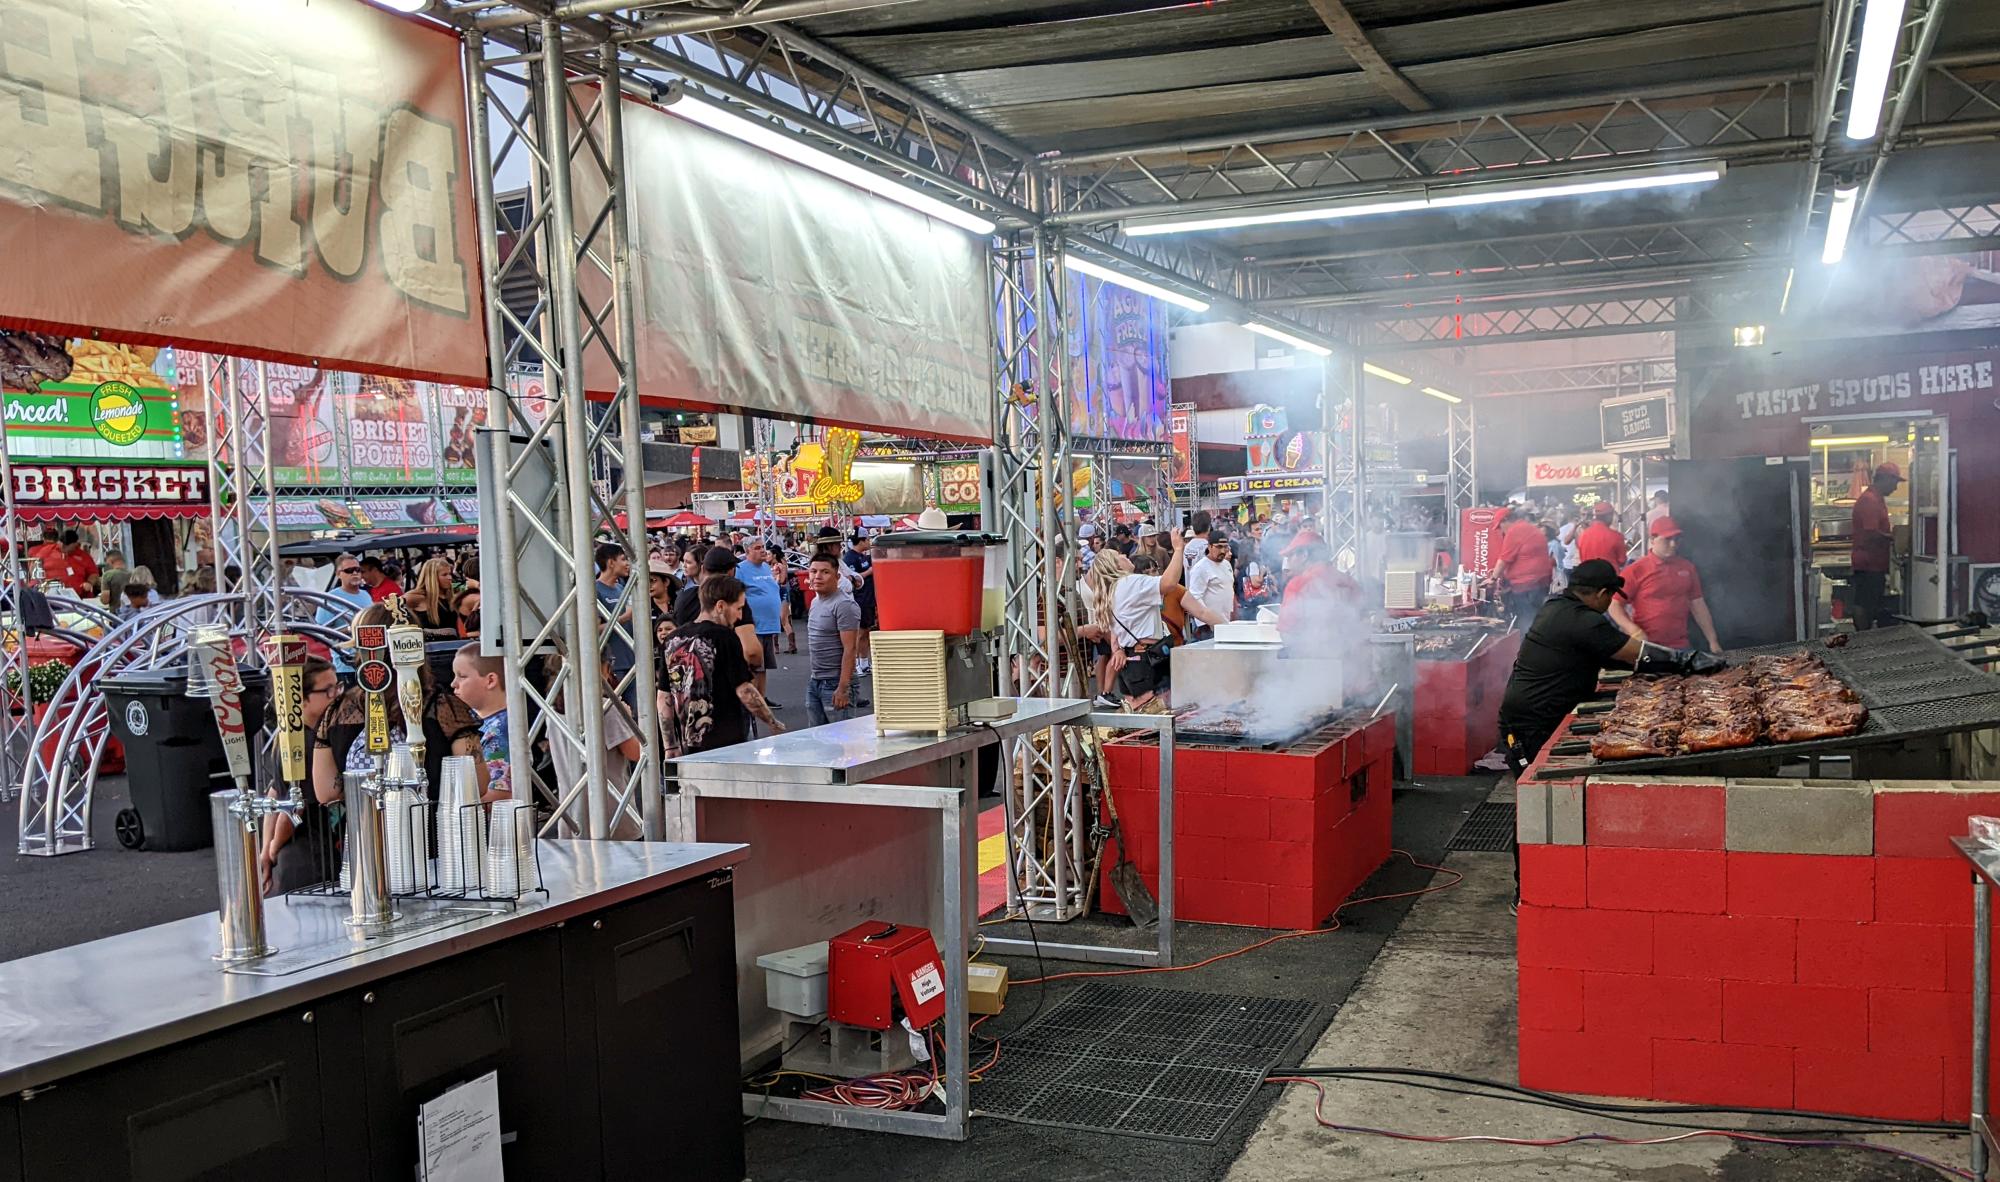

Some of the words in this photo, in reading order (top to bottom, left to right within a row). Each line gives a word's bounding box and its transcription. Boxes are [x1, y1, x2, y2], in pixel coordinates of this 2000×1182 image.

[100, 382, 132, 397] FRESH
[1736, 383, 1820, 418] TASTY
[1828, 372, 1912, 407] SPUDS
[1919, 361, 1993, 395] HERE
[93, 401, 143, 422] Lemonade
[1621, 405, 1648, 423] SPUD
[97, 423, 142, 442] SQUEEZED
[351, 419, 428, 442] BRISKET
[353, 442, 430, 467] POTATO
[941, 464, 980, 483] ROA
[1535, 463, 1581, 480] Coors
[12, 467, 206, 501] BRISKET
[813, 476, 858, 500] Corn
[1249, 480, 1271, 490] ICE
[1274, 475, 1324, 489] CREAM
[393, 639, 423, 651] Modelo
[286, 672, 305, 734] Coors
[224, 735, 246, 746] LIGHT
[921, 978, 932, 987] High
